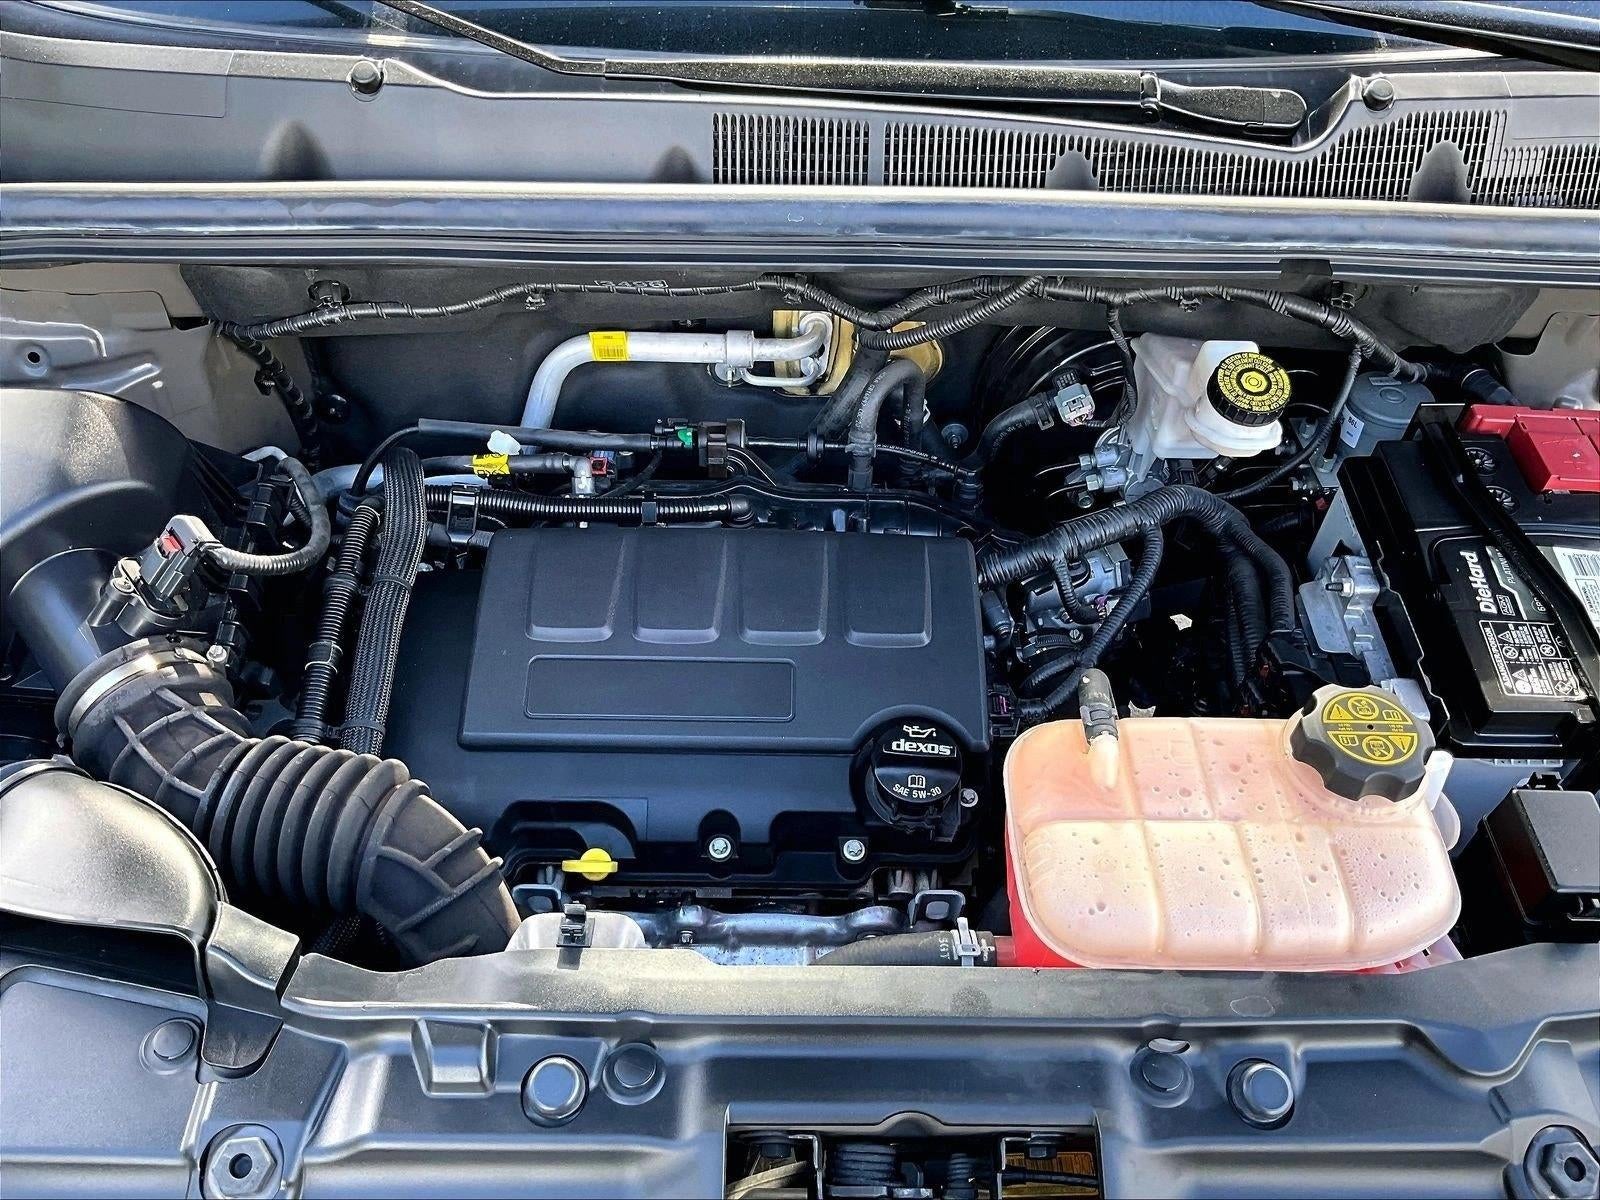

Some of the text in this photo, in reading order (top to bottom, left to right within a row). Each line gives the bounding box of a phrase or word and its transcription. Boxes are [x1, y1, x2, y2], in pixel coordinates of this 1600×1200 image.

[1495, 548, 1516, 584] PLATINU
[1460, 551, 1498, 614] DieHard
[891, 738, 952, 756] dexos
[892, 783, 942, 799] SAE 5W-30
